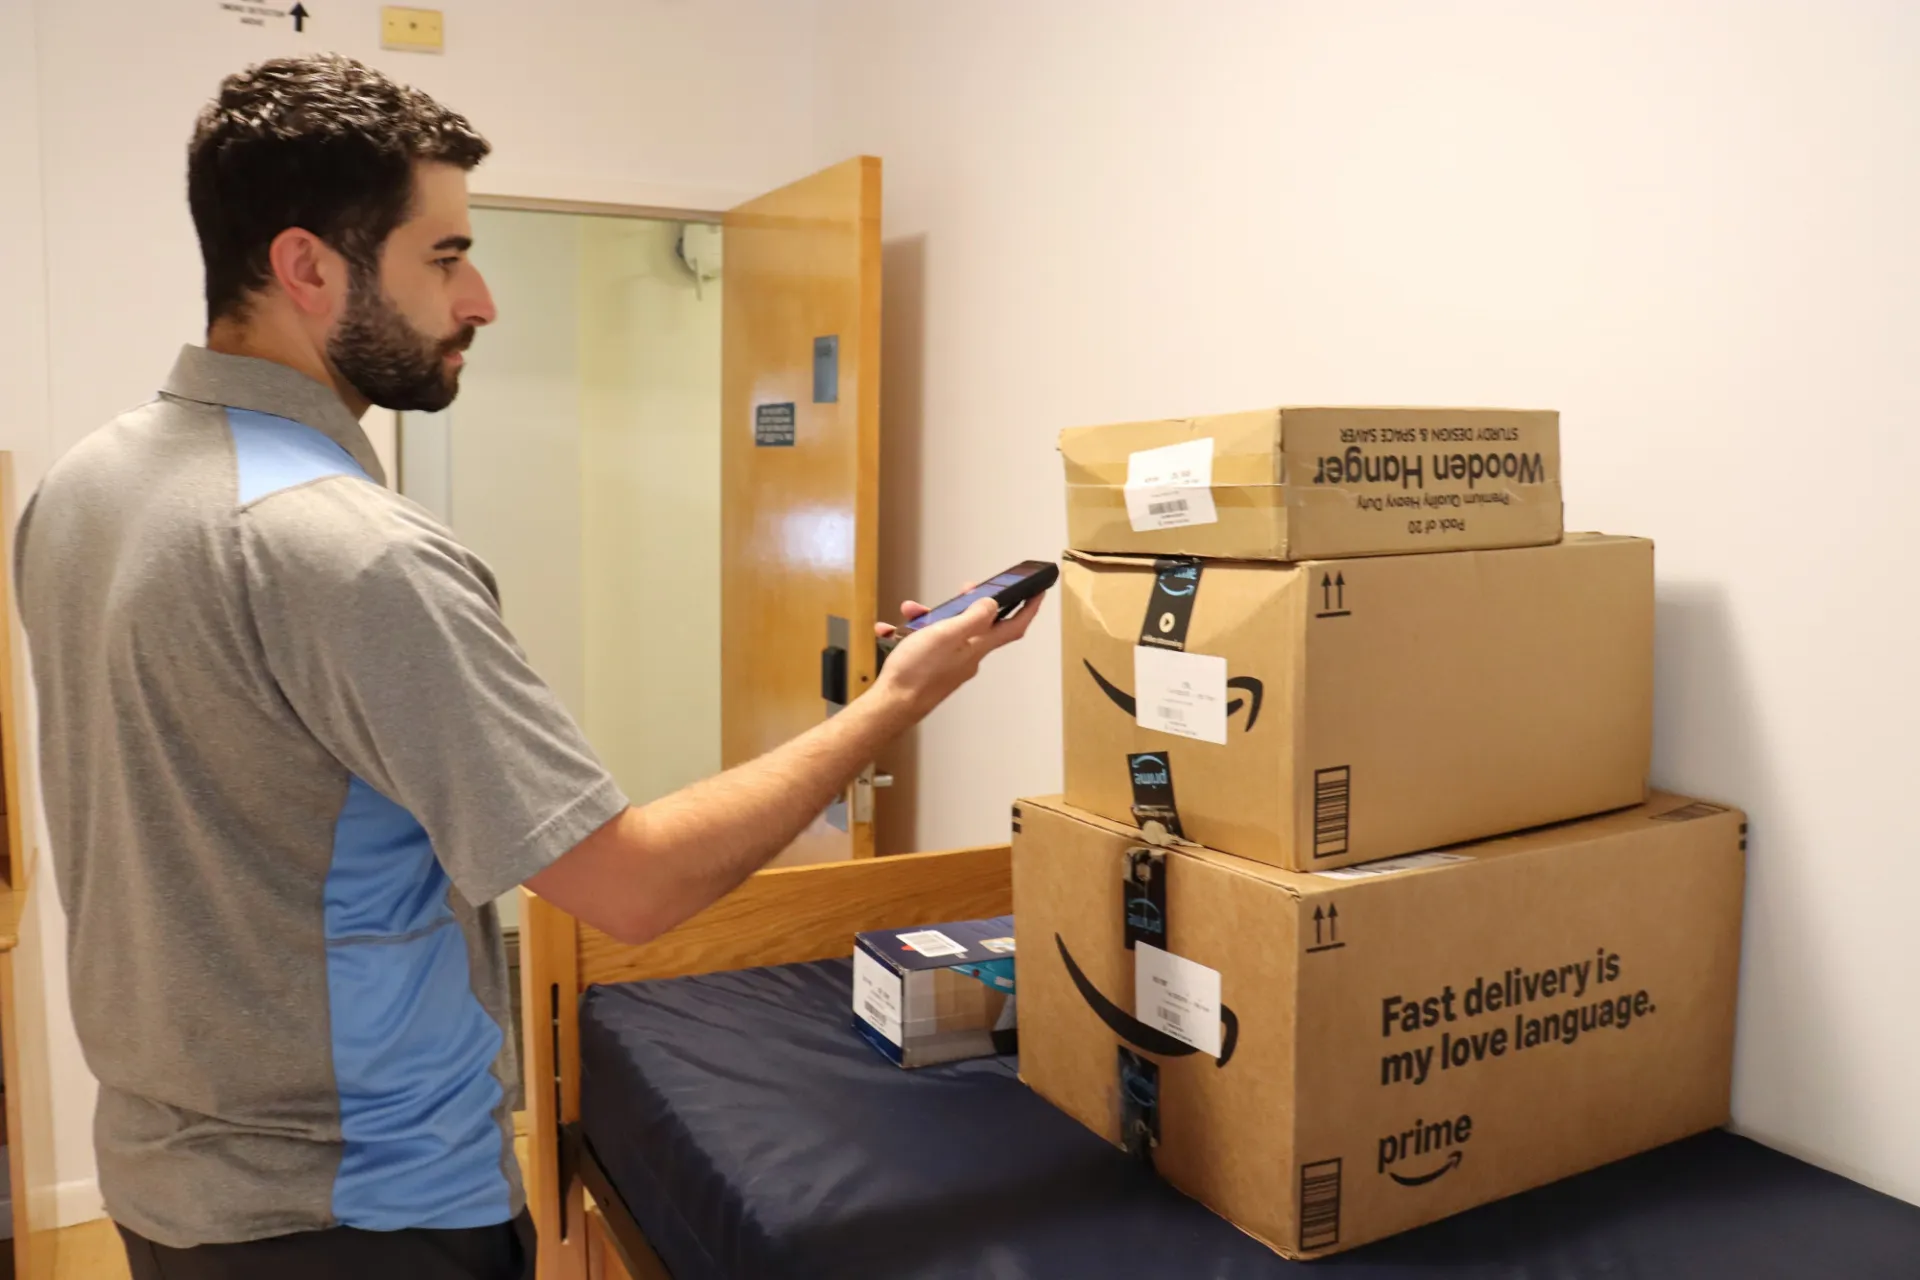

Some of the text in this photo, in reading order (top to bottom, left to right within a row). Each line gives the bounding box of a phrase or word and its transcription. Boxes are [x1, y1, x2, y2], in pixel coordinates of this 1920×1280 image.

[1340, 427, 1519, 443] STURDY DESIGN & SPACE SAVER
[1313, 446, 1544, 489] Wooden Hanger
[1356, 492, 1509, 511] Premium Quality Heavy Duty
[1408, 518, 1465, 534] Pack of 20
[1134, 768, 1167, 789] prime
[1382, 947, 1620, 1037] Fast delivery is
[1381, 990, 1656, 1086] my love language.
[1378, 1114, 1473, 1174] prime
